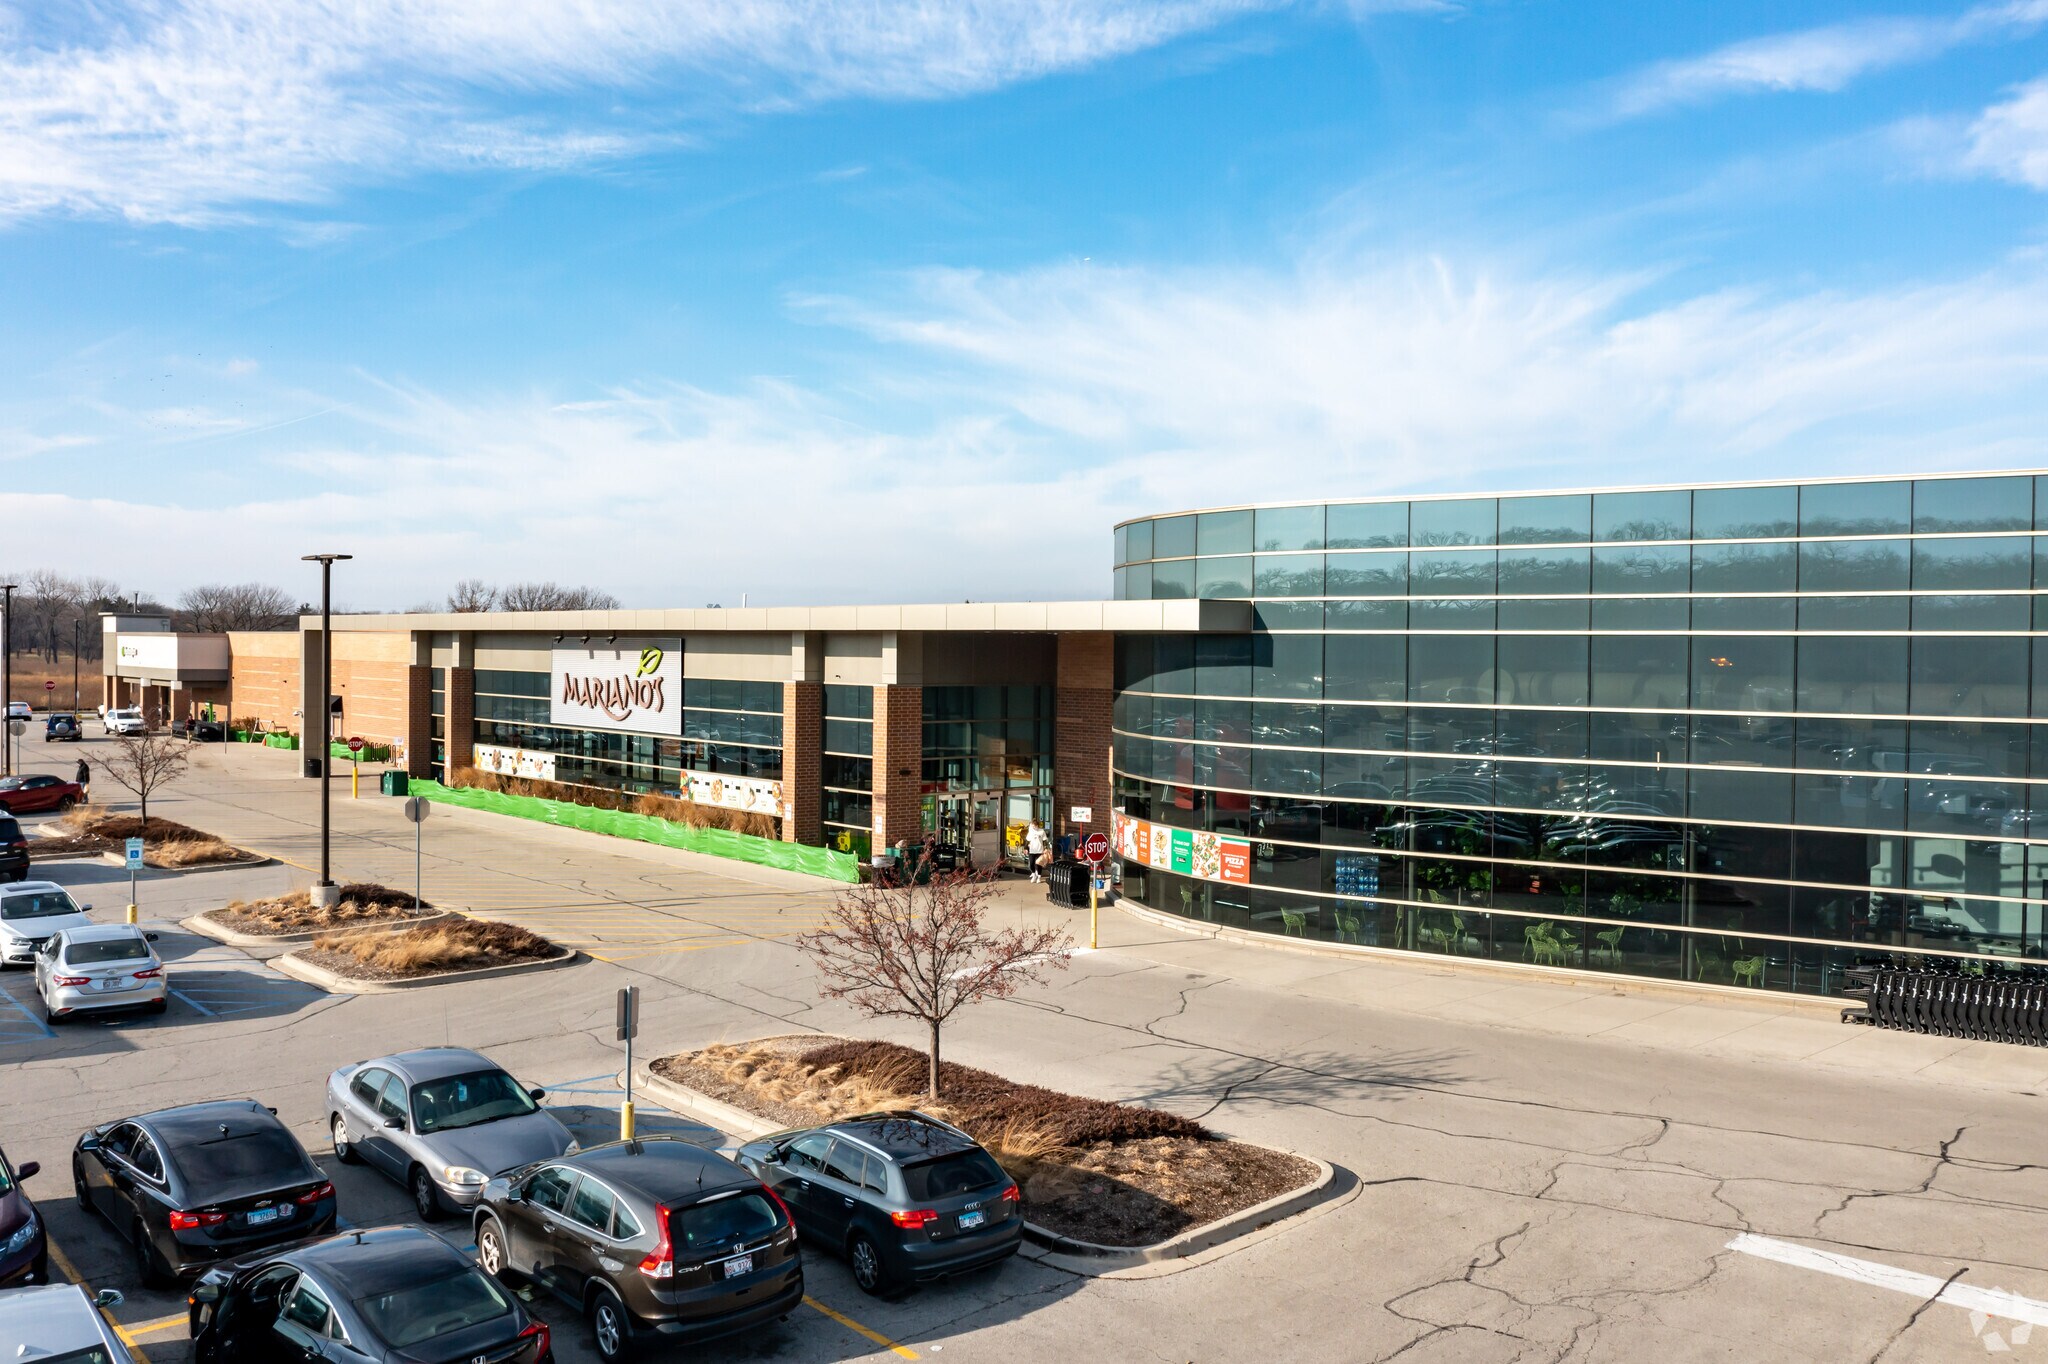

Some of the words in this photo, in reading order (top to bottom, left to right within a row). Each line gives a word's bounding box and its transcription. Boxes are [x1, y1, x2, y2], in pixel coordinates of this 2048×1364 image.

[562, 672, 664, 721] MARIANO'S
[1087, 841, 1107, 854] STOP
[1225, 856, 1245, 867] PIZZA
